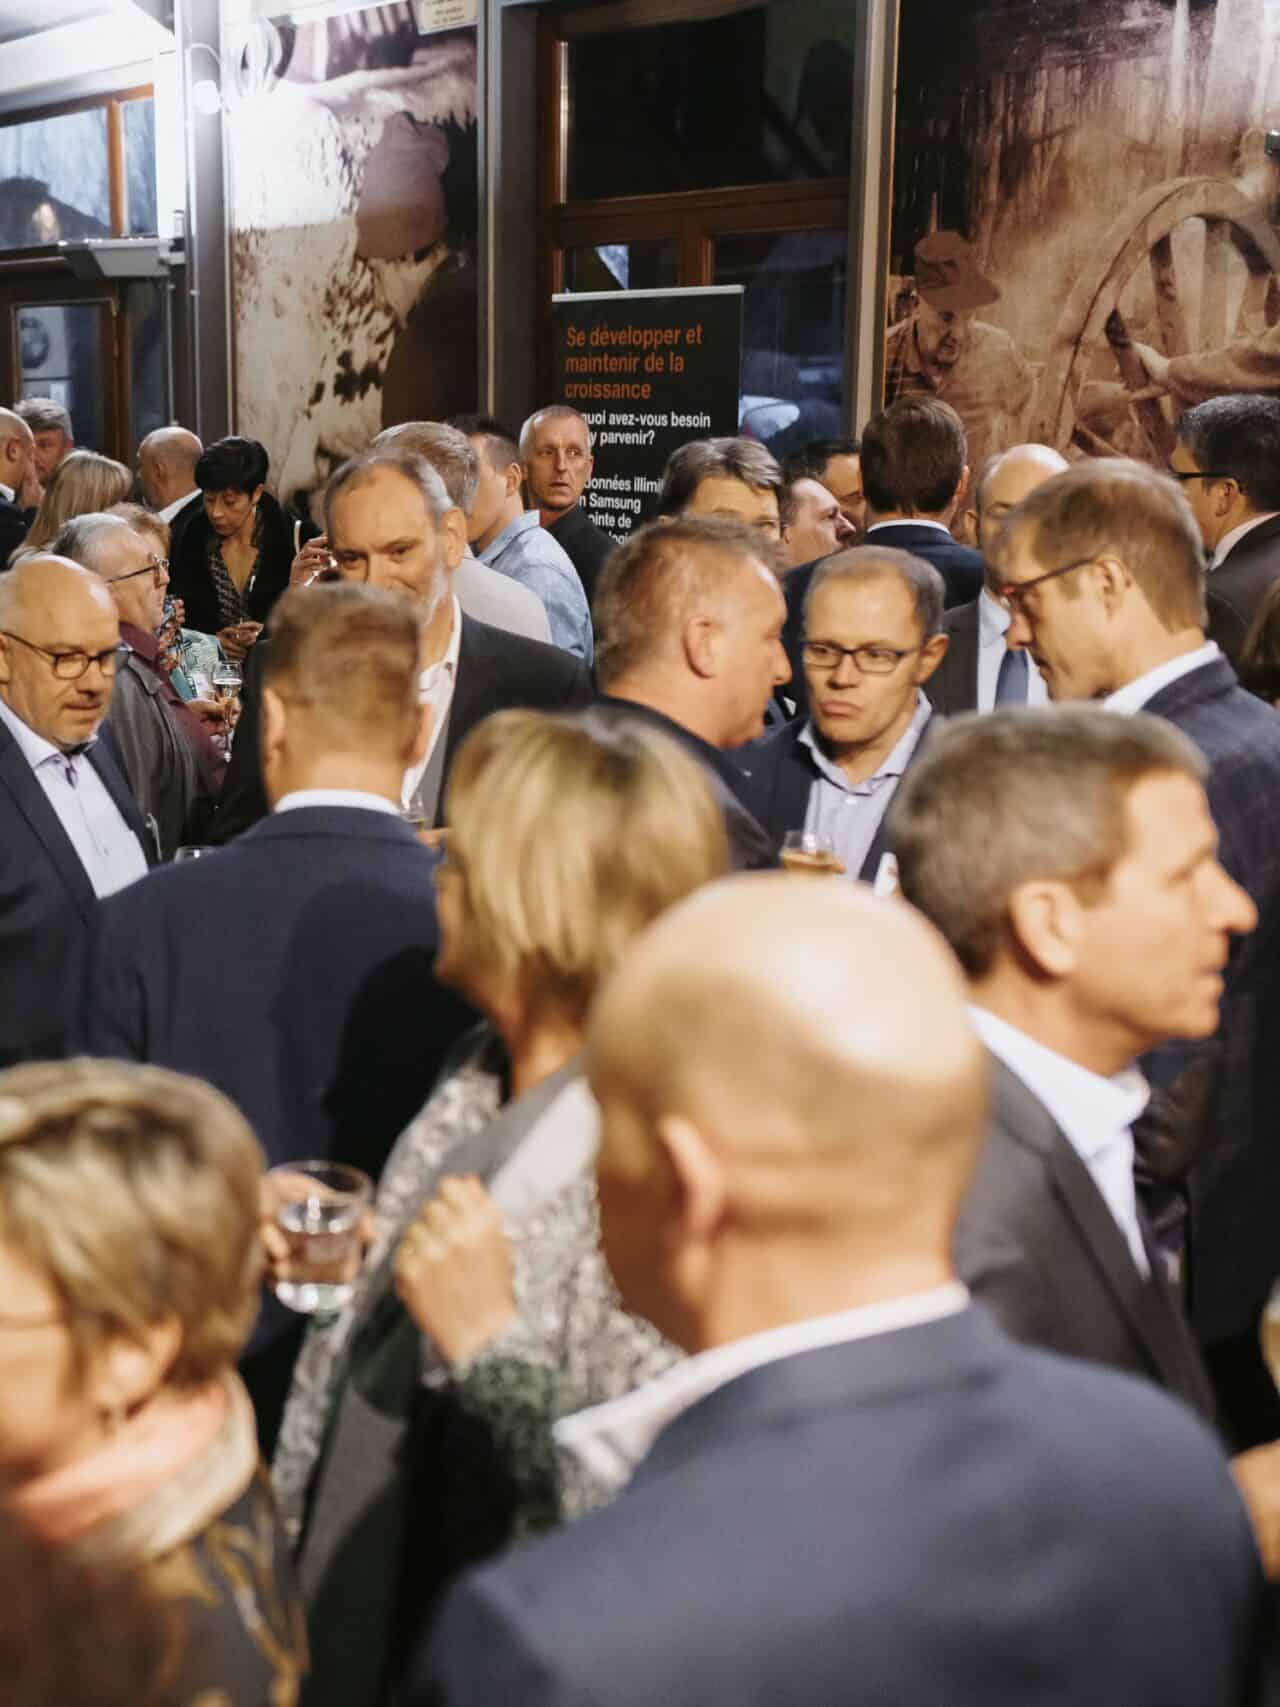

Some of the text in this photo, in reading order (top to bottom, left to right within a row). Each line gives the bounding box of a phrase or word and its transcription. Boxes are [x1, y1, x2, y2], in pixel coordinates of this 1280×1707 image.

[567, 322, 704, 350] Se développer et
[565, 352, 685, 373] maintenir de la
[565, 379, 651, 399] croissance
[609, 412, 668, 426] avez-vous
[671, 411, 711, 428] besoin
[590, 429, 655, 447] y parvenir?
[589, 492, 641, 514] Samsung
[617, 512, 632, 528] de
